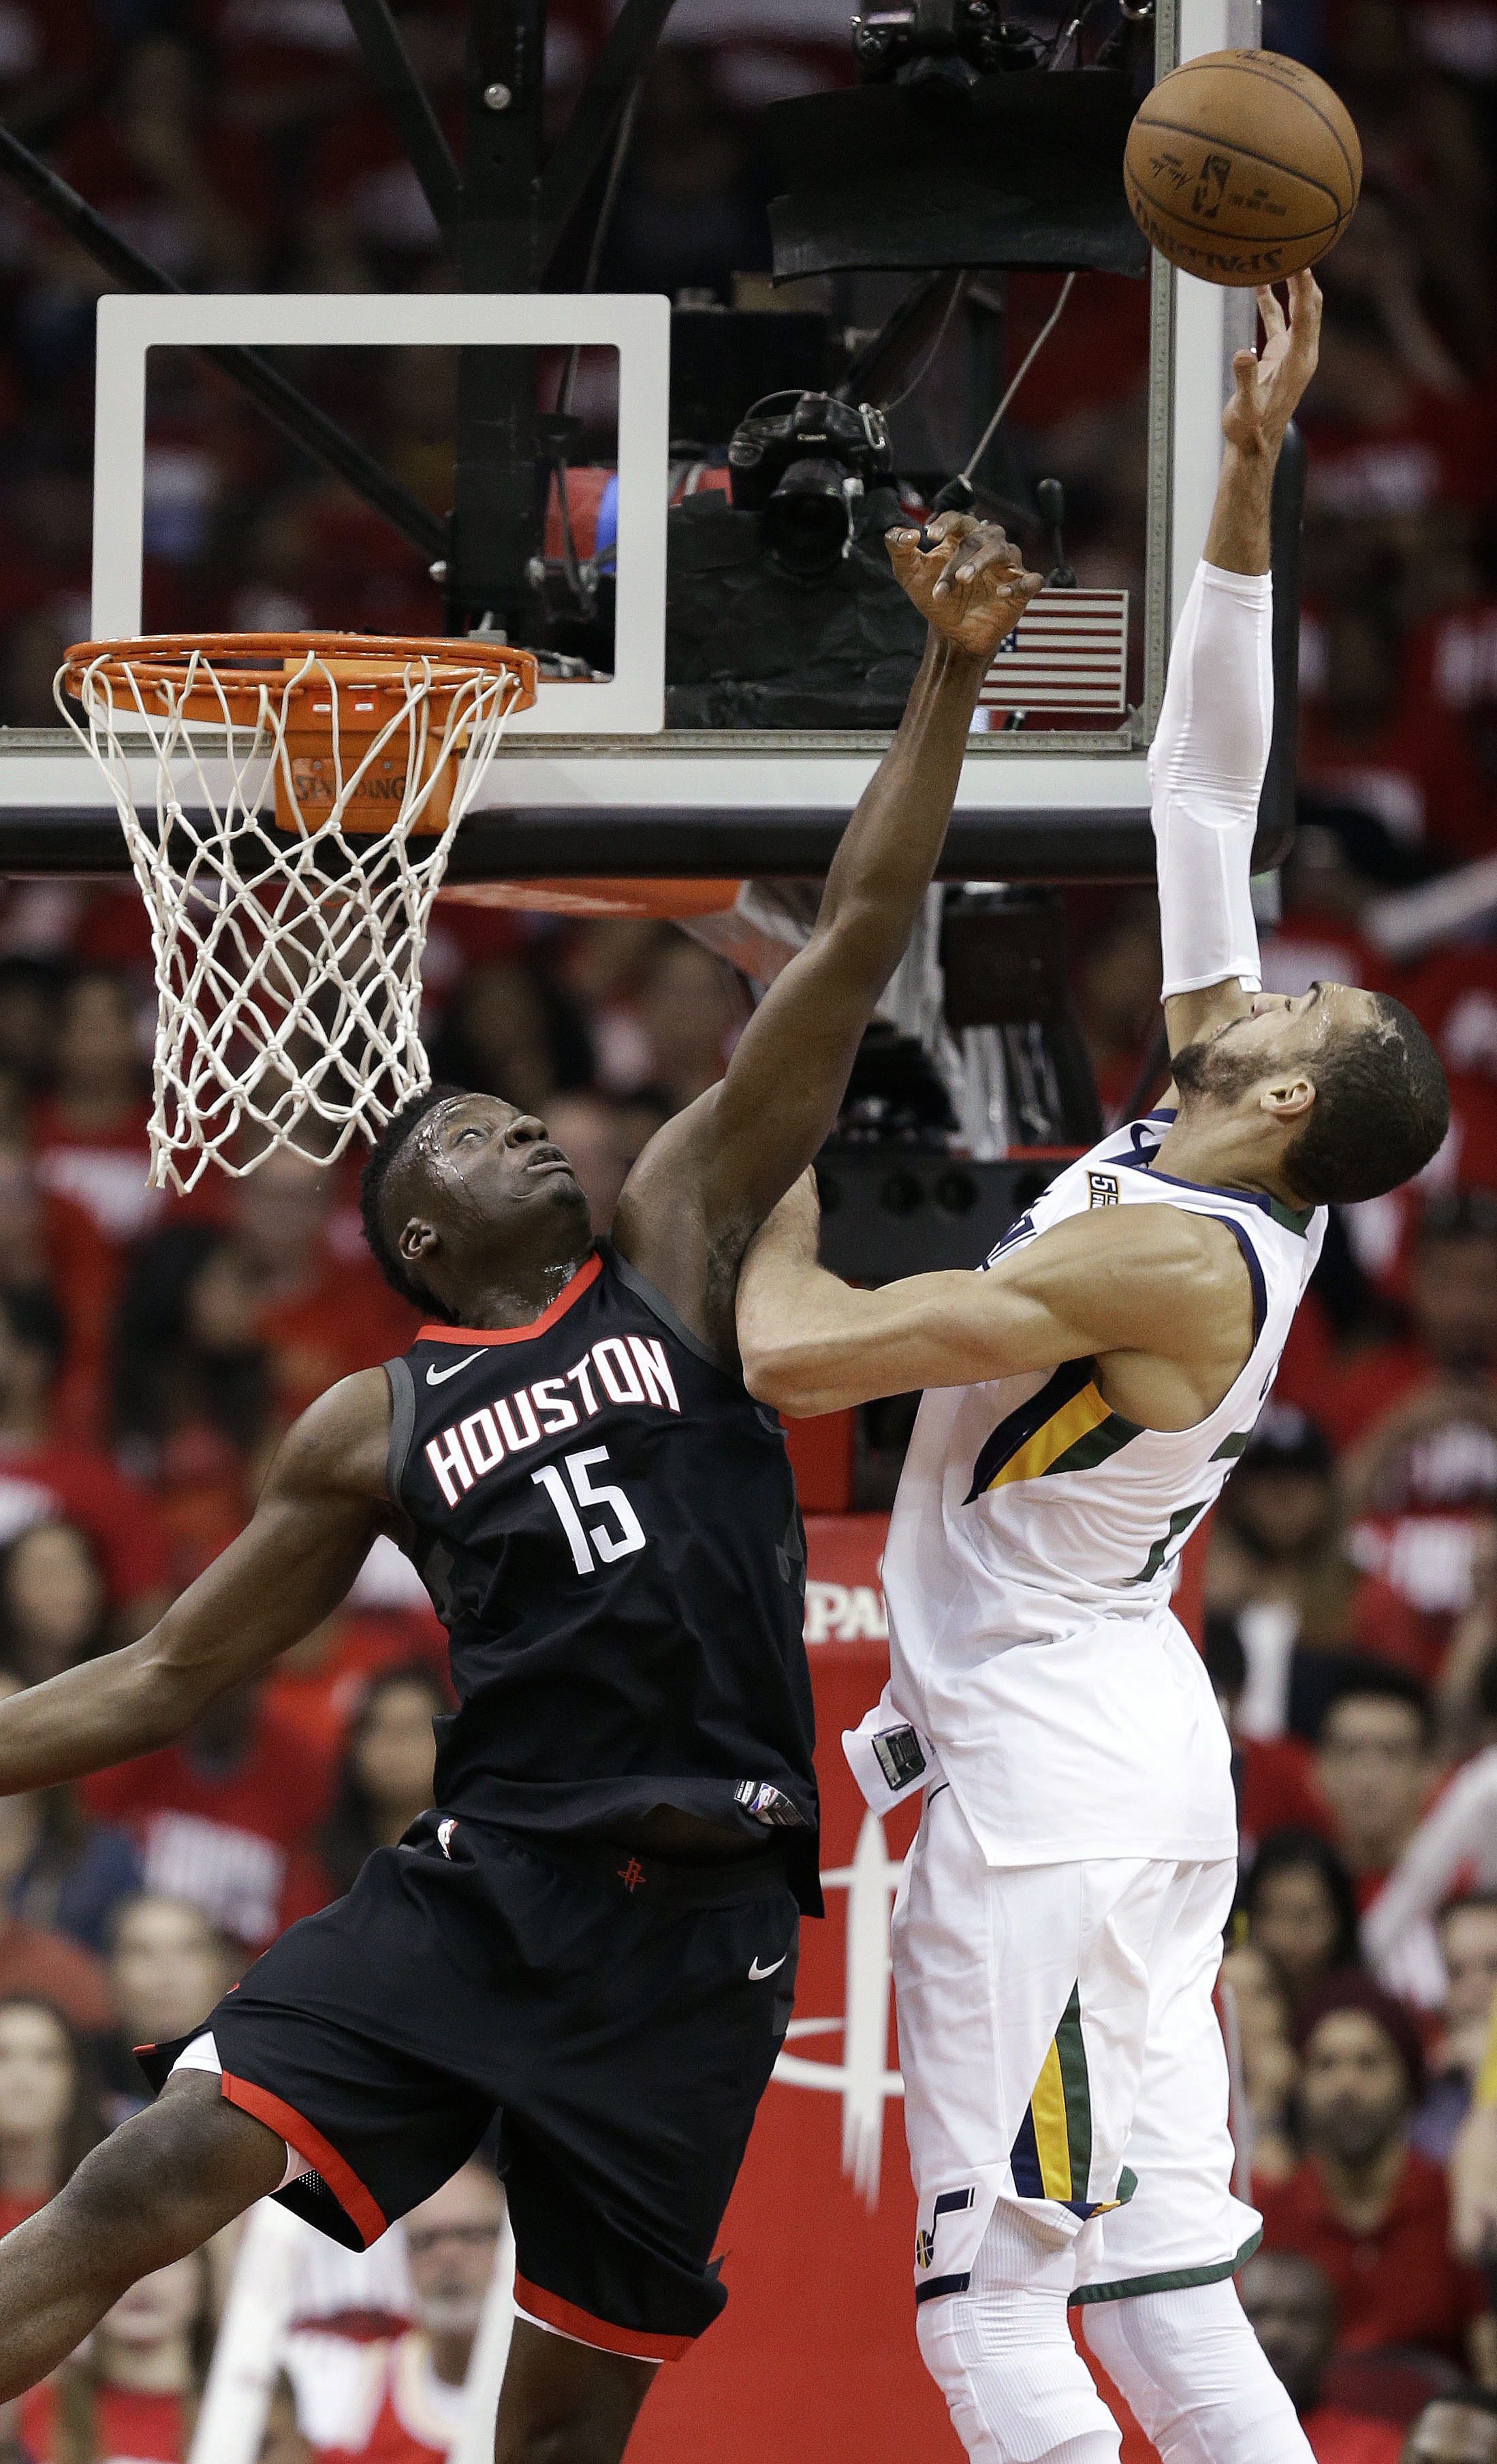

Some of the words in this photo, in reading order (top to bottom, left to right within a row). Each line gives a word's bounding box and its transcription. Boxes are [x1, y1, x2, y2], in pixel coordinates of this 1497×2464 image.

[295, 775, 407, 801] SPADING
[1091, 1176, 1117, 1192] 5
[424, 1334, 680, 1509] HOUSTON
[531, 1445, 646, 1575] 15
